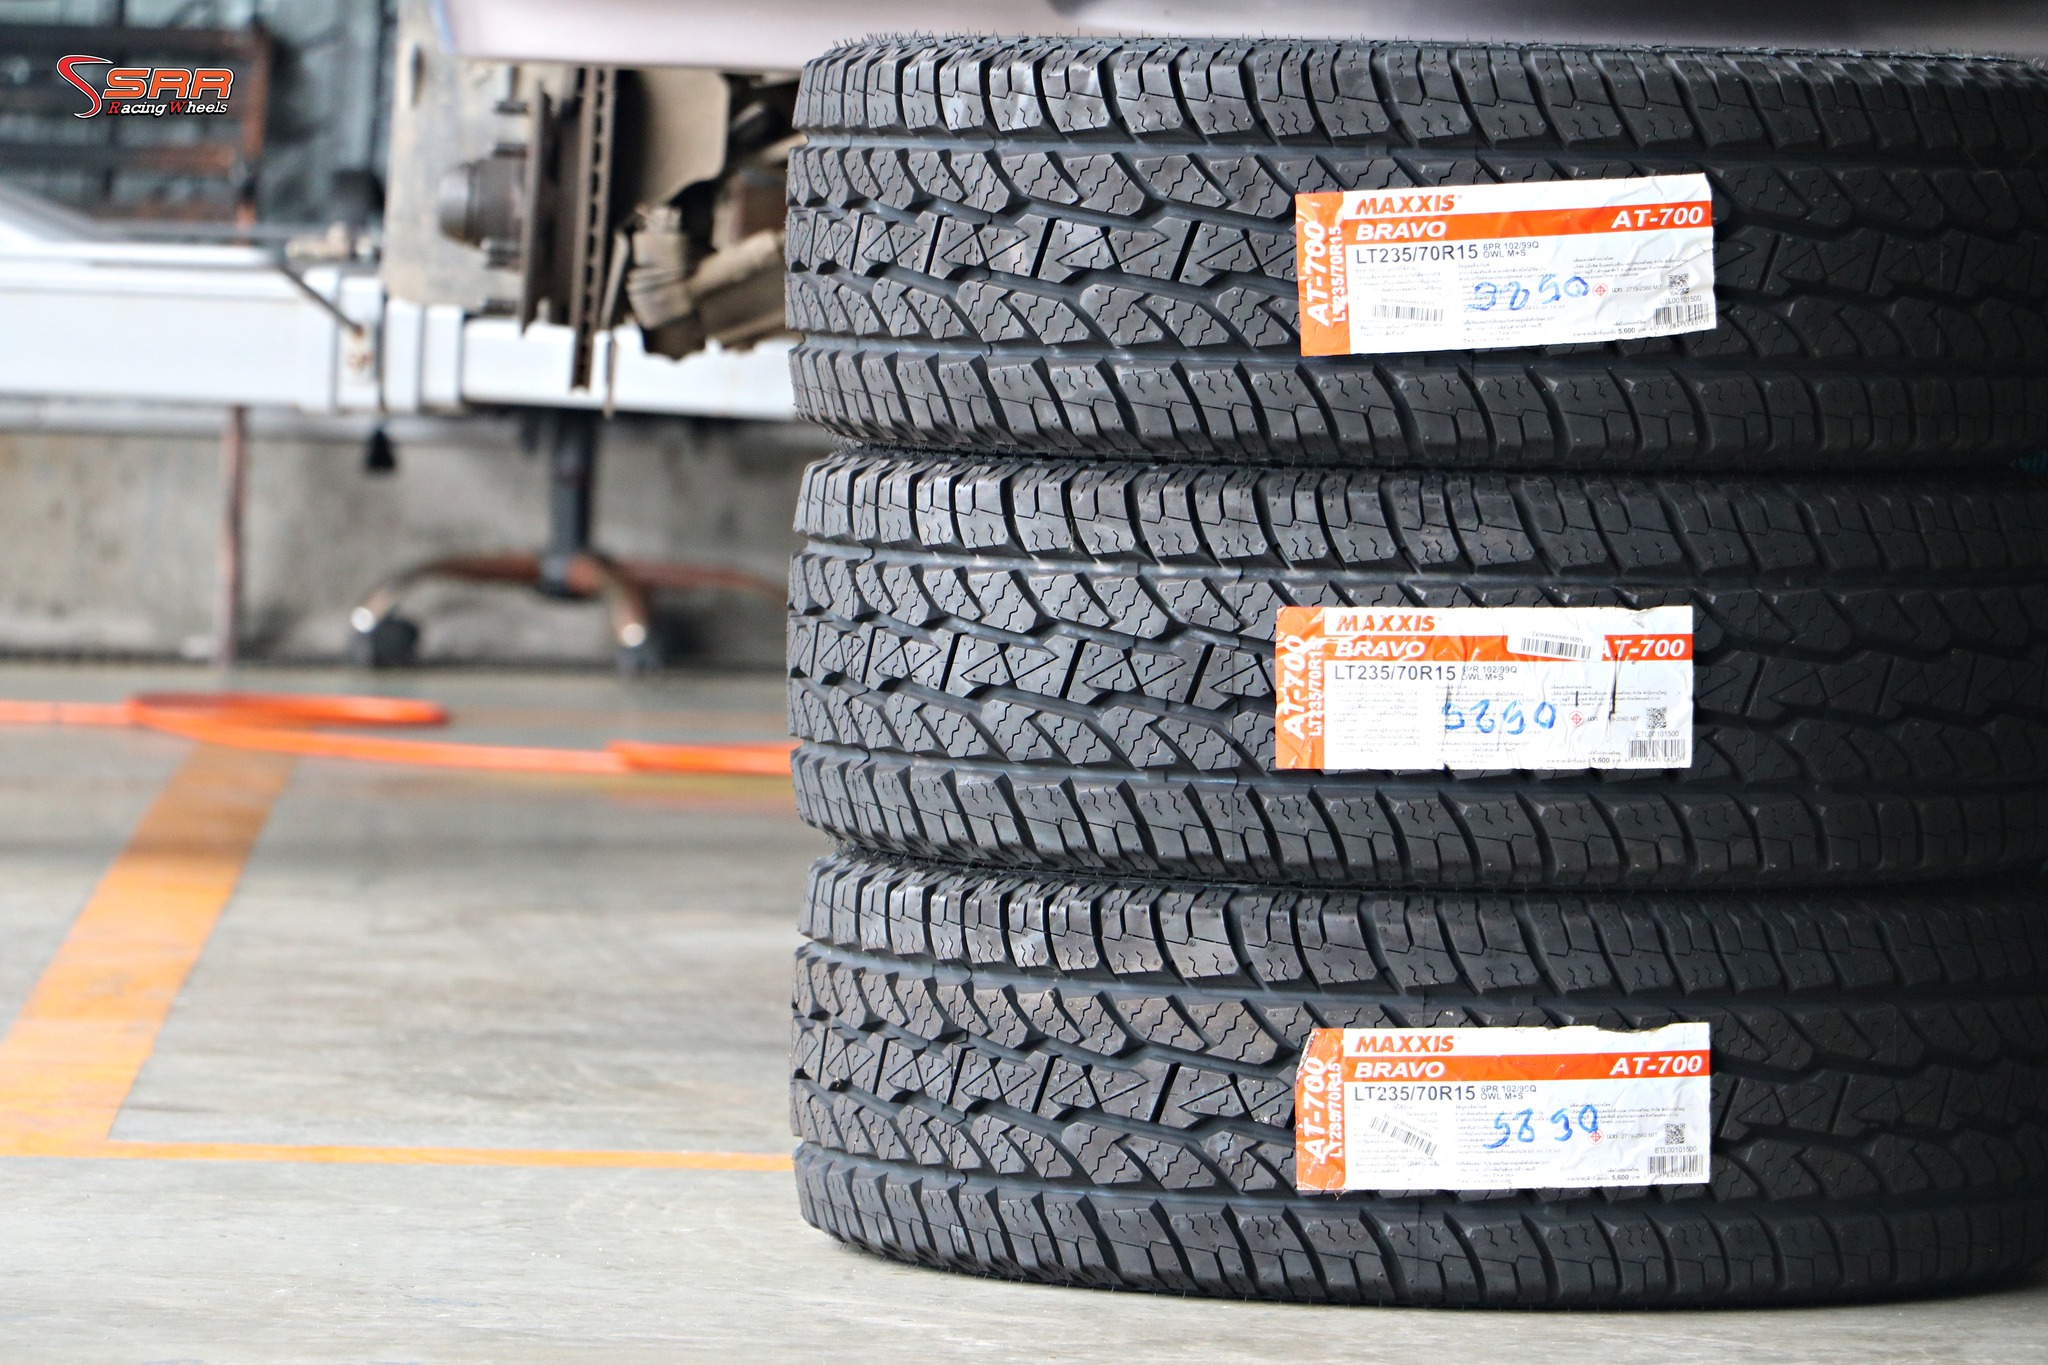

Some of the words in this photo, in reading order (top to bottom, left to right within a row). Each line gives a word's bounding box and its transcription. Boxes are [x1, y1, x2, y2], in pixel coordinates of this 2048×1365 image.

[1355, 194, 1455, 216] MAXXIS
[1610, 206, 1704, 229] AT-700
[1355, 220, 1447, 241] BRAVO
[1356, 244, 1479, 264] LT235/70R15
[1483, 242, 1501, 251] 6PR
[1504, 240, 1539, 250] 102/99Q
[1483, 250, 1505, 258] OWL
[1507, 249, 1526, 257] M+S
[1303, 220, 1330, 328] AT-700
[1618, 327, 1636, 335] 5,600
[1335, 614, 1436, 632] MAXXIS
[1334, 640, 1426, 658] BRAVO
[1335, 664, 1456, 681] LT235/70R15
[1461, 673, 1482, 681] OWL
[1485, 673, 1504, 681] M+S
[1482, 665, 1518, 673] 102/99Q
[1283, 634, 1306, 741] AT-700
[1354, 1035, 1455, 1053] MAXXIS
[1354, 1061, 1445, 1079] BRAVO
[1609, 1055, 1703, 1076] AT-700
[1354, 1085, 1476, 1101] LT235/70R15
[1480, 1085, 1499, 1093] 6PR
[1480, 1092, 1502, 1100] OWL
[1504, 1092, 1524, 1100] M+S
[1303, 1056, 1326, 1165] AT-700
